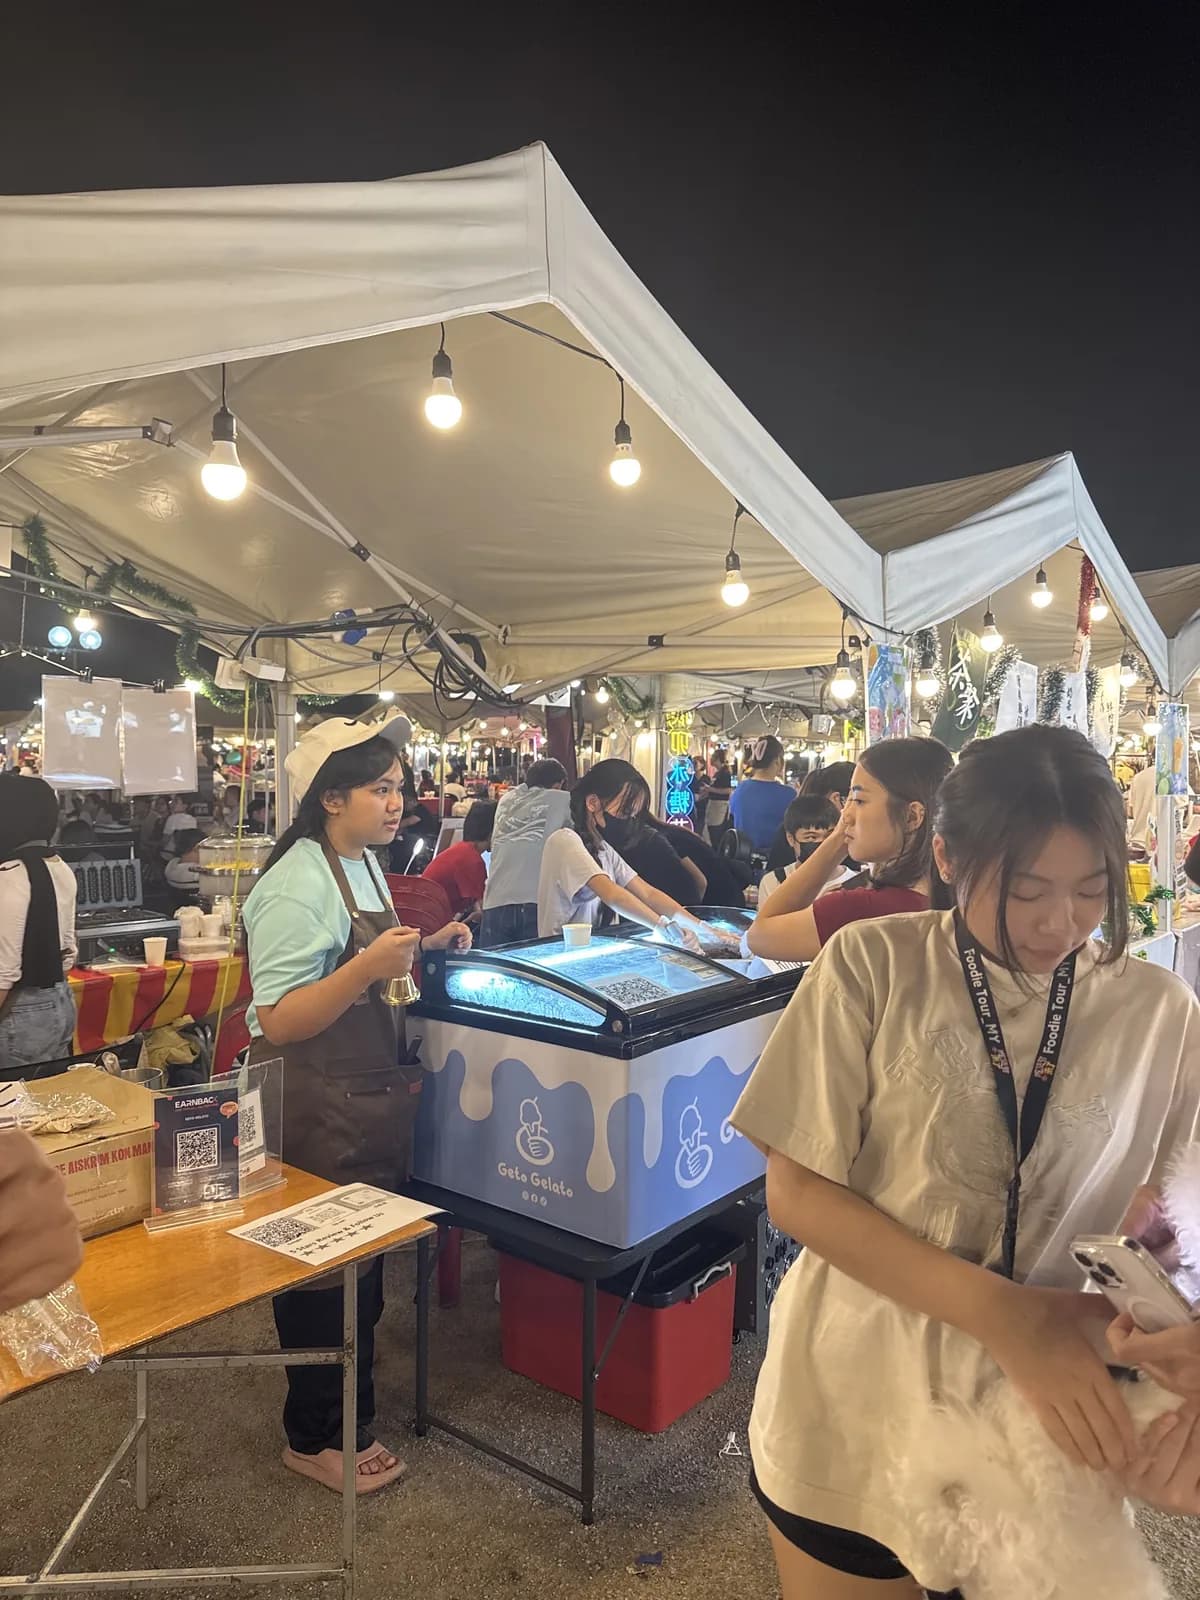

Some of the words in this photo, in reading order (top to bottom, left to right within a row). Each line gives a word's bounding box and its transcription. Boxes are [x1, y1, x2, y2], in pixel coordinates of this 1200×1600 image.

[964, 948, 982, 988] Foodie
[975, 988, 1001, 1044] Tour_MY
[1043, 1013, 1062, 1054] Foodie
[68, 1151, 110, 1175] AISKRIM
[111, 1146, 131, 1163] KON
[498, 1162, 528, 1183] Geto
[530, 1172, 574, 1198] Gelato
